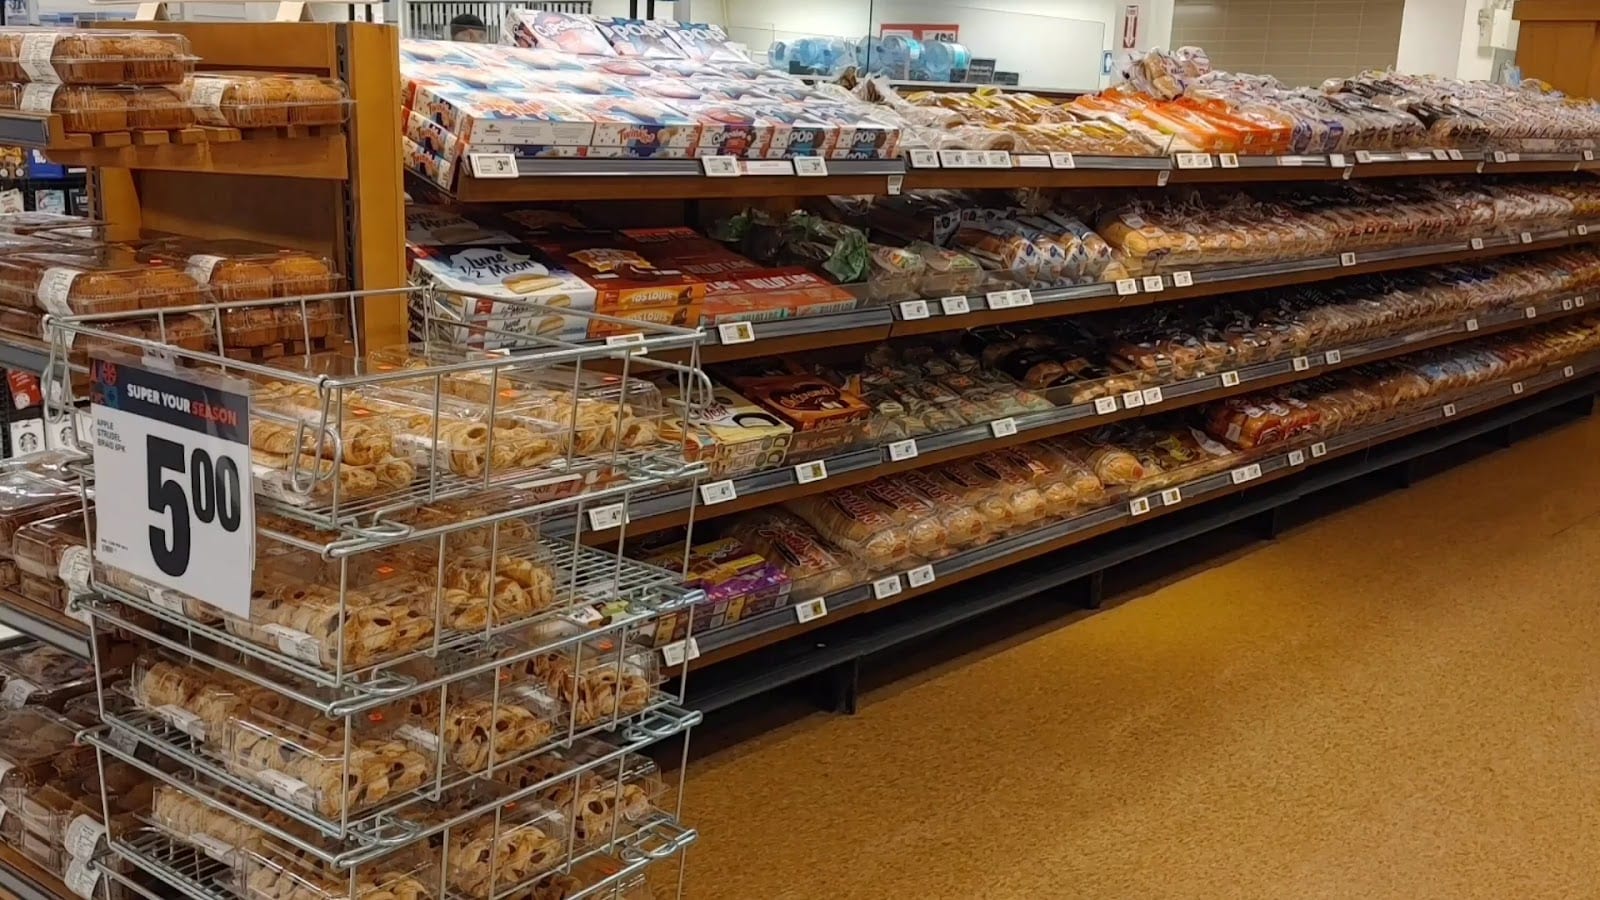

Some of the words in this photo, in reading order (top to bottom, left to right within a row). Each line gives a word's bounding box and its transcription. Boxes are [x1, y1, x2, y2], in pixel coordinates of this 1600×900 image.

[788, 130, 815, 143] POP
[852, 130, 877, 144] POP
[464, 251, 505, 269] Lune
[486, 260, 535, 277] Moon
[127, 383, 160, 405] SUPER
[161, 391, 191, 413] YOUR
[191, 400, 238, 426] SEASON
[97, 418, 114, 431] APPLE
[97, 429, 122, 443] STRUDEL
[146, 434, 191, 578] 5
